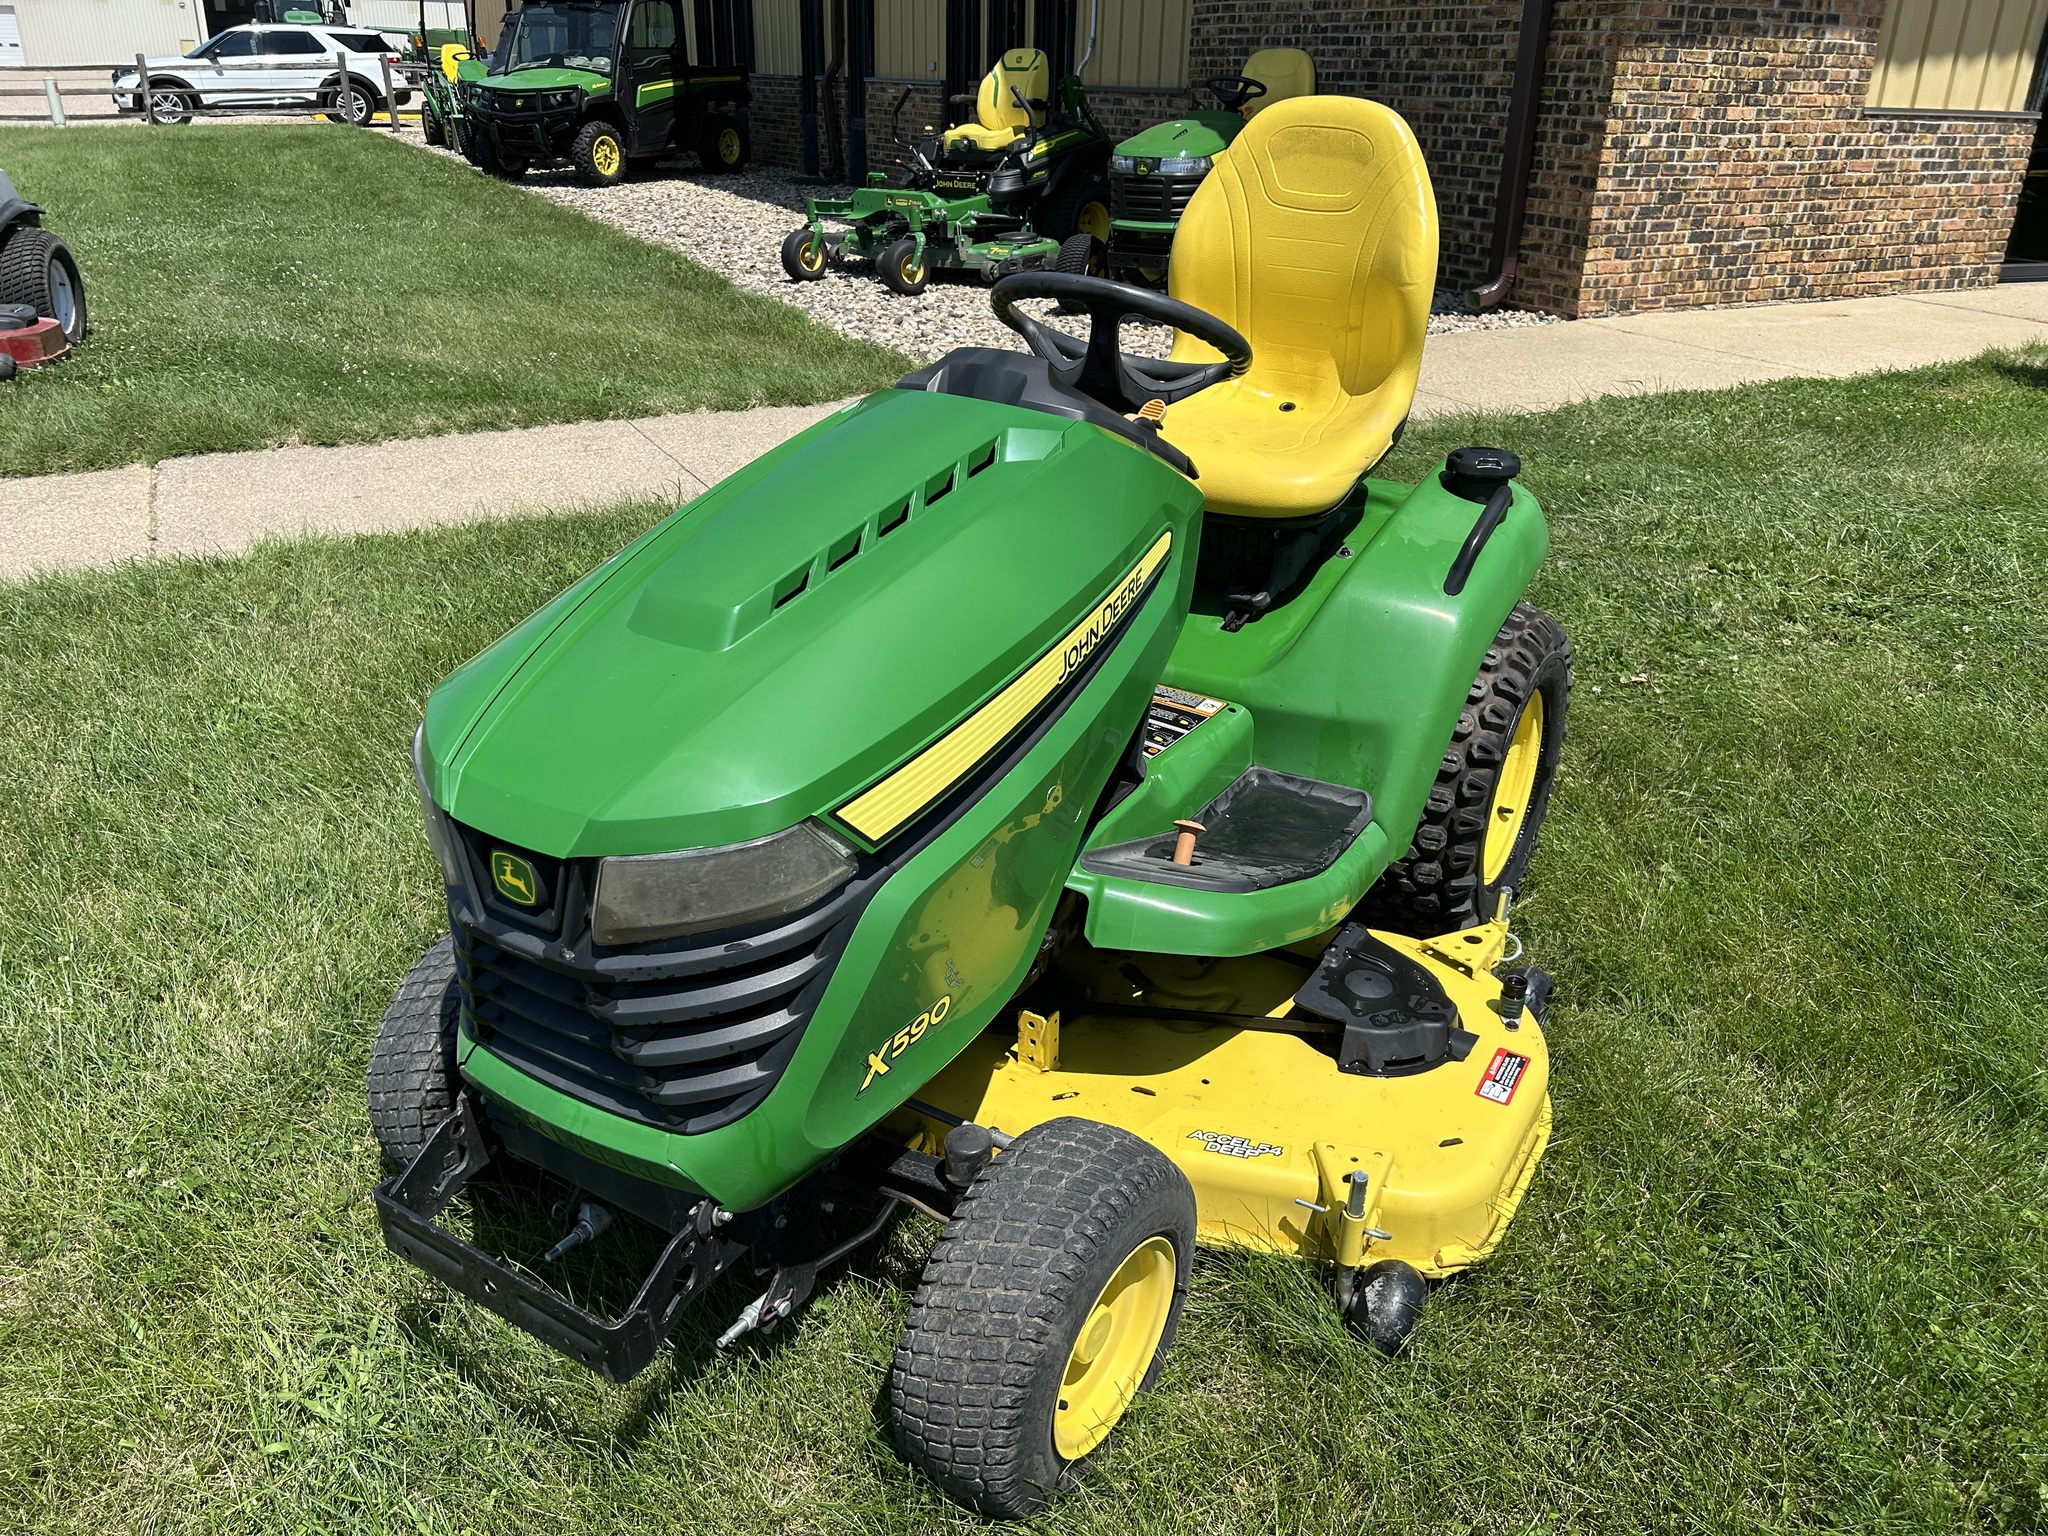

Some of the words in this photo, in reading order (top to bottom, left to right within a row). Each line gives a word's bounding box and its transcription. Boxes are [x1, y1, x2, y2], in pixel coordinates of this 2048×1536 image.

[935, 179, 953, 188] JOHN
[953, 180, 976, 189] DEERE
[1058, 619, 1100, 683] JOHN
[1102, 566, 1143, 633] DEERE
[857, 994, 951, 1096] X590
[1186, 1129, 1255, 1151] ACCEL
[1256, 1142, 1284, 1156] 54
[1203, 1141, 1261, 1159] DEEP
